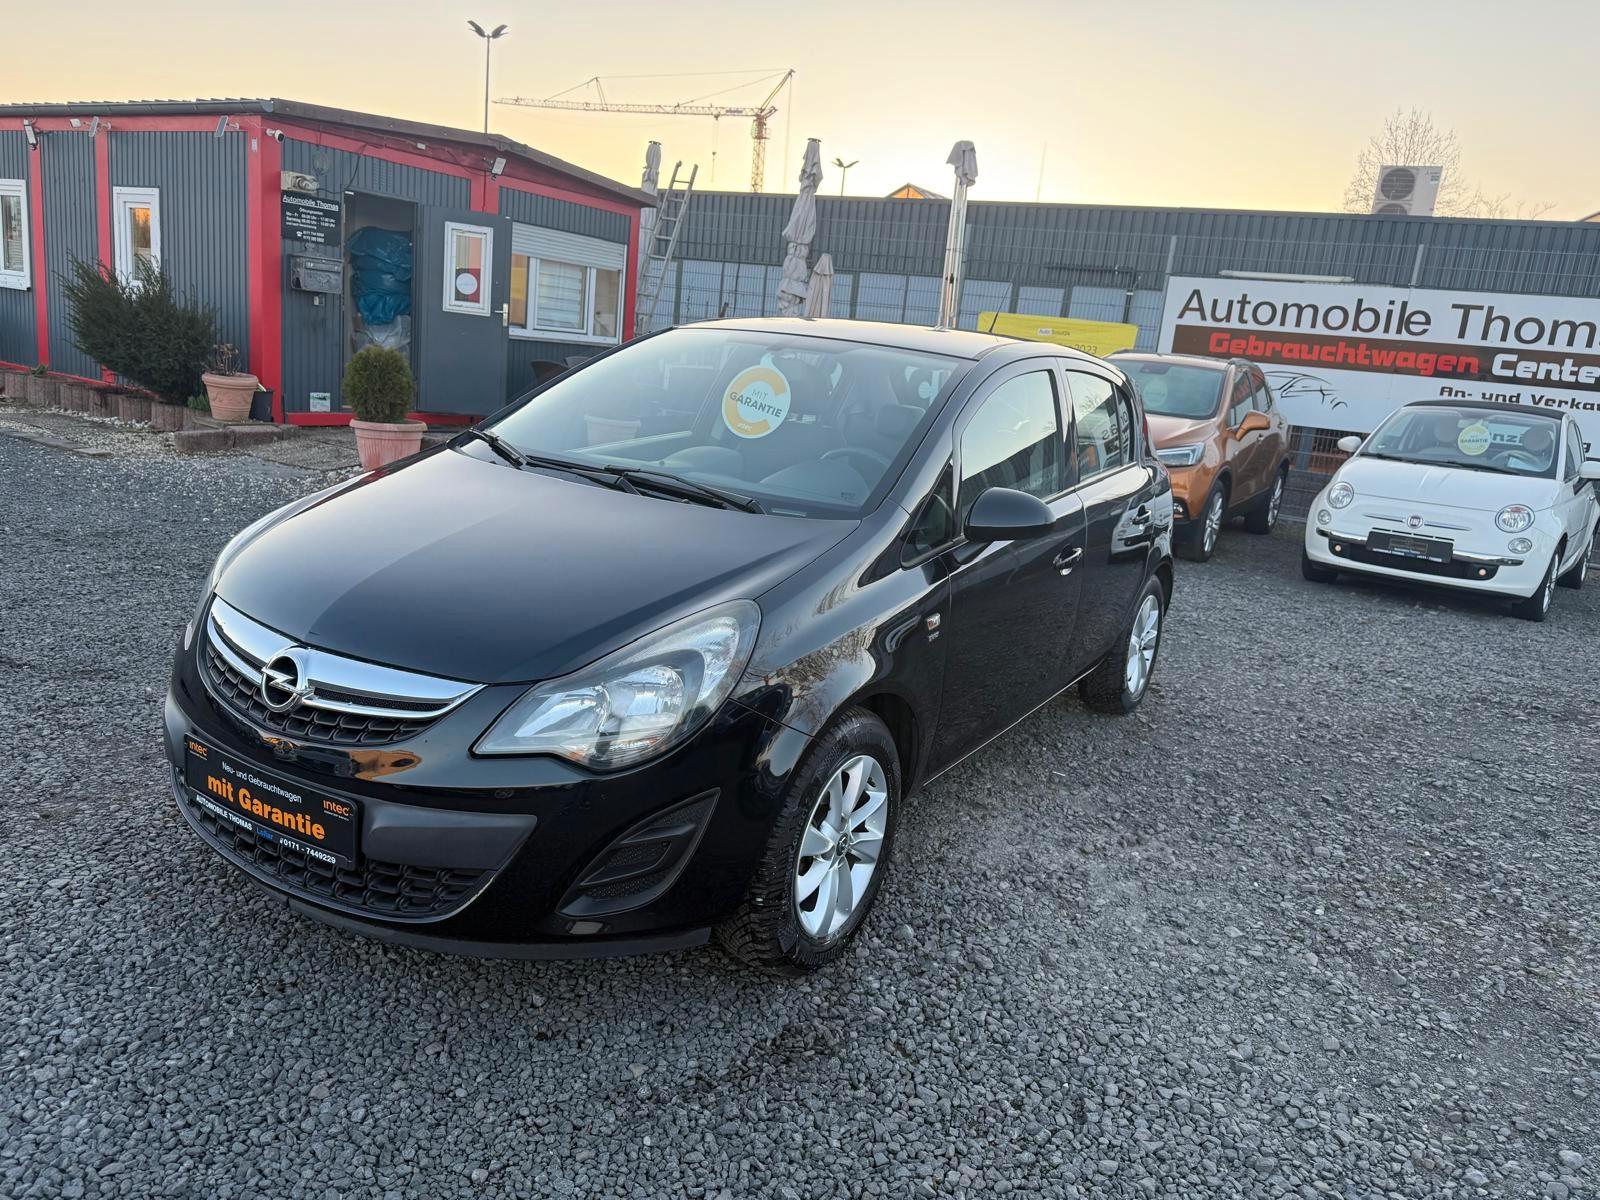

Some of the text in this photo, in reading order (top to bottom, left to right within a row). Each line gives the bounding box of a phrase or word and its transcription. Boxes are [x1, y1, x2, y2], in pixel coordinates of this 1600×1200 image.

[1177, 288, 1600, 349] Automobile Thom
[1209, 332, 1479, 376] Gebrauchtwagen
[729, 391, 783, 418] GARANTIE
[751, 389, 768, 401] MIT
[1439, 386, 1600, 411] An- und Verka
[222, 761, 302, 804] Neu- und Gebrauchtwagen
[196, 794, 228, 818] AUTOMOBILE
[228, 812, 253, 831] THOMAS
[306, 847, 336, 864] 7449229
[207, 775, 326, 840] mit Garantie
[323, 800, 349, 816] intec
